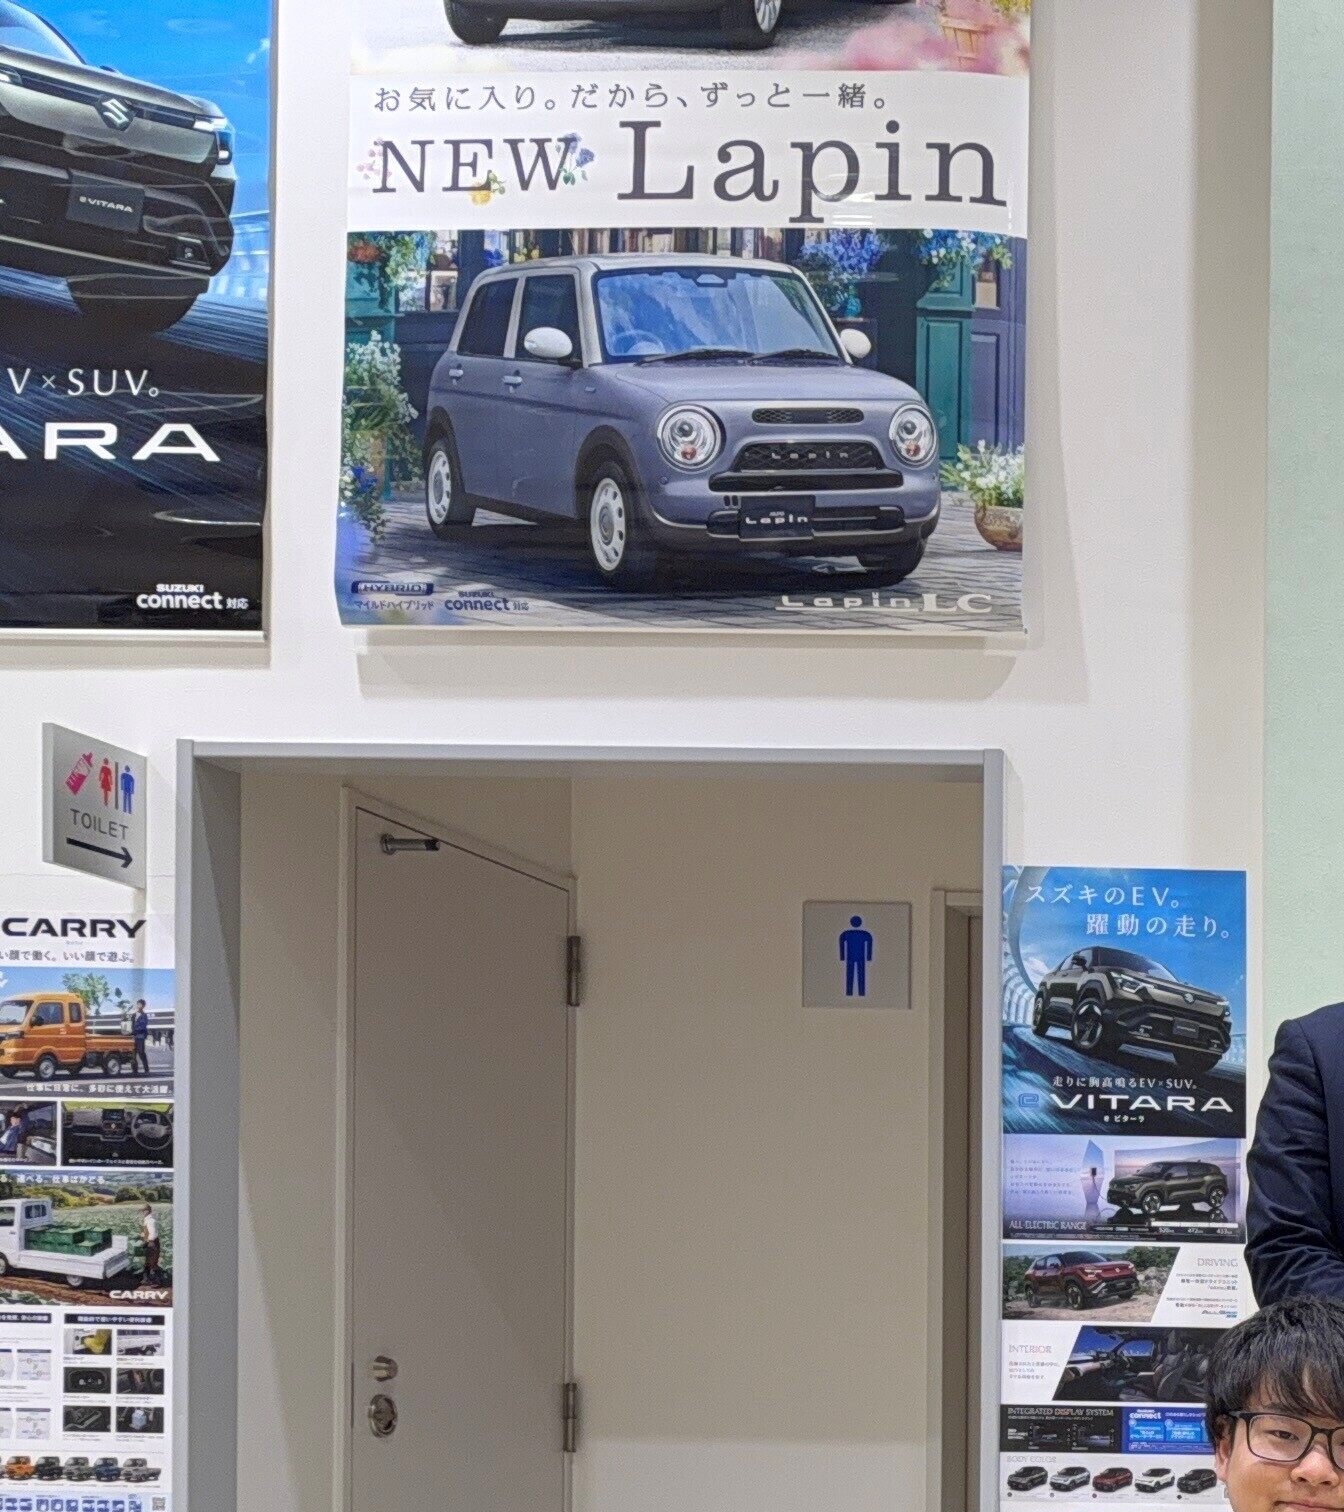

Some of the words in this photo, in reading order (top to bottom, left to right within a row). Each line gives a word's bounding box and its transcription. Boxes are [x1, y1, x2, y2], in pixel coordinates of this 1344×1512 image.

[374, 82, 886, 112] お気に入り。だから、ずっと一緒。
[372, 136, 580, 193] NEW
[617, 119, 1007, 223] Lapin
[156, 583, 205, 593] SUZUKI
[136, 592, 223, 609] connect
[445, 597, 510, 611] connect
[69, 808, 129, 840] TOILET
[1025, 885, 1179, 909] スズキのEV。
[1, 917, 147, 939] CARRY
[1086, 913, 1230, 939] 躍動の走り。
[1051, 1093, 1234, 1113] VITARA
[109, 1290, 168, 1300] CARRY
